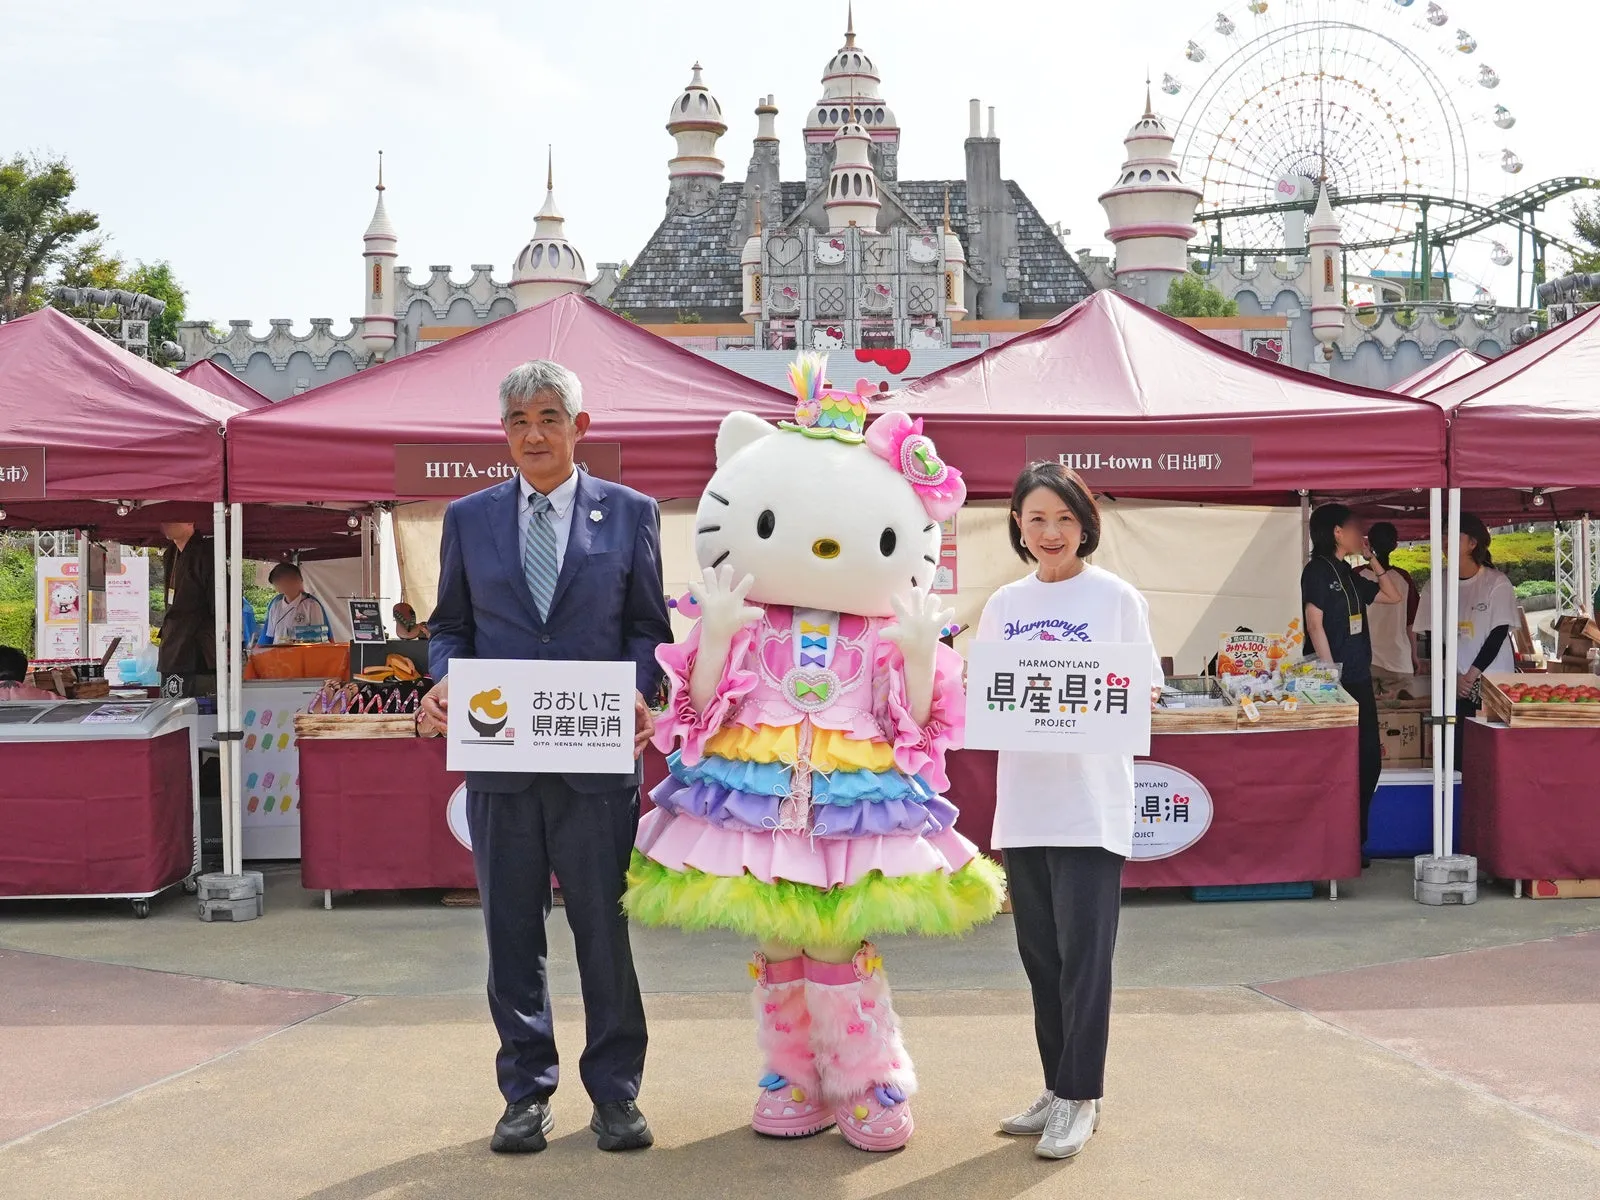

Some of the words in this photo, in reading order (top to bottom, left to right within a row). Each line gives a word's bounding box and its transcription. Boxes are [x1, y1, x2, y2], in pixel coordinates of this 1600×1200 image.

[425, 462, 519, 480] HITA-city
[1059, 453, 1152, 469] HIJI-town
[1157, 453, 1222, 470] 《日出町》
[1019, 659, 1100, 669] HARMONYLAND
[532, 691, 620, 711] おおいた
[986, 672, 1130, 714] 県産県消
[532, 715, 621, 737] 県産県消
[1034, 718, 1077, 728] PROJECT
[1134, 794, 1190, 824] 県消
